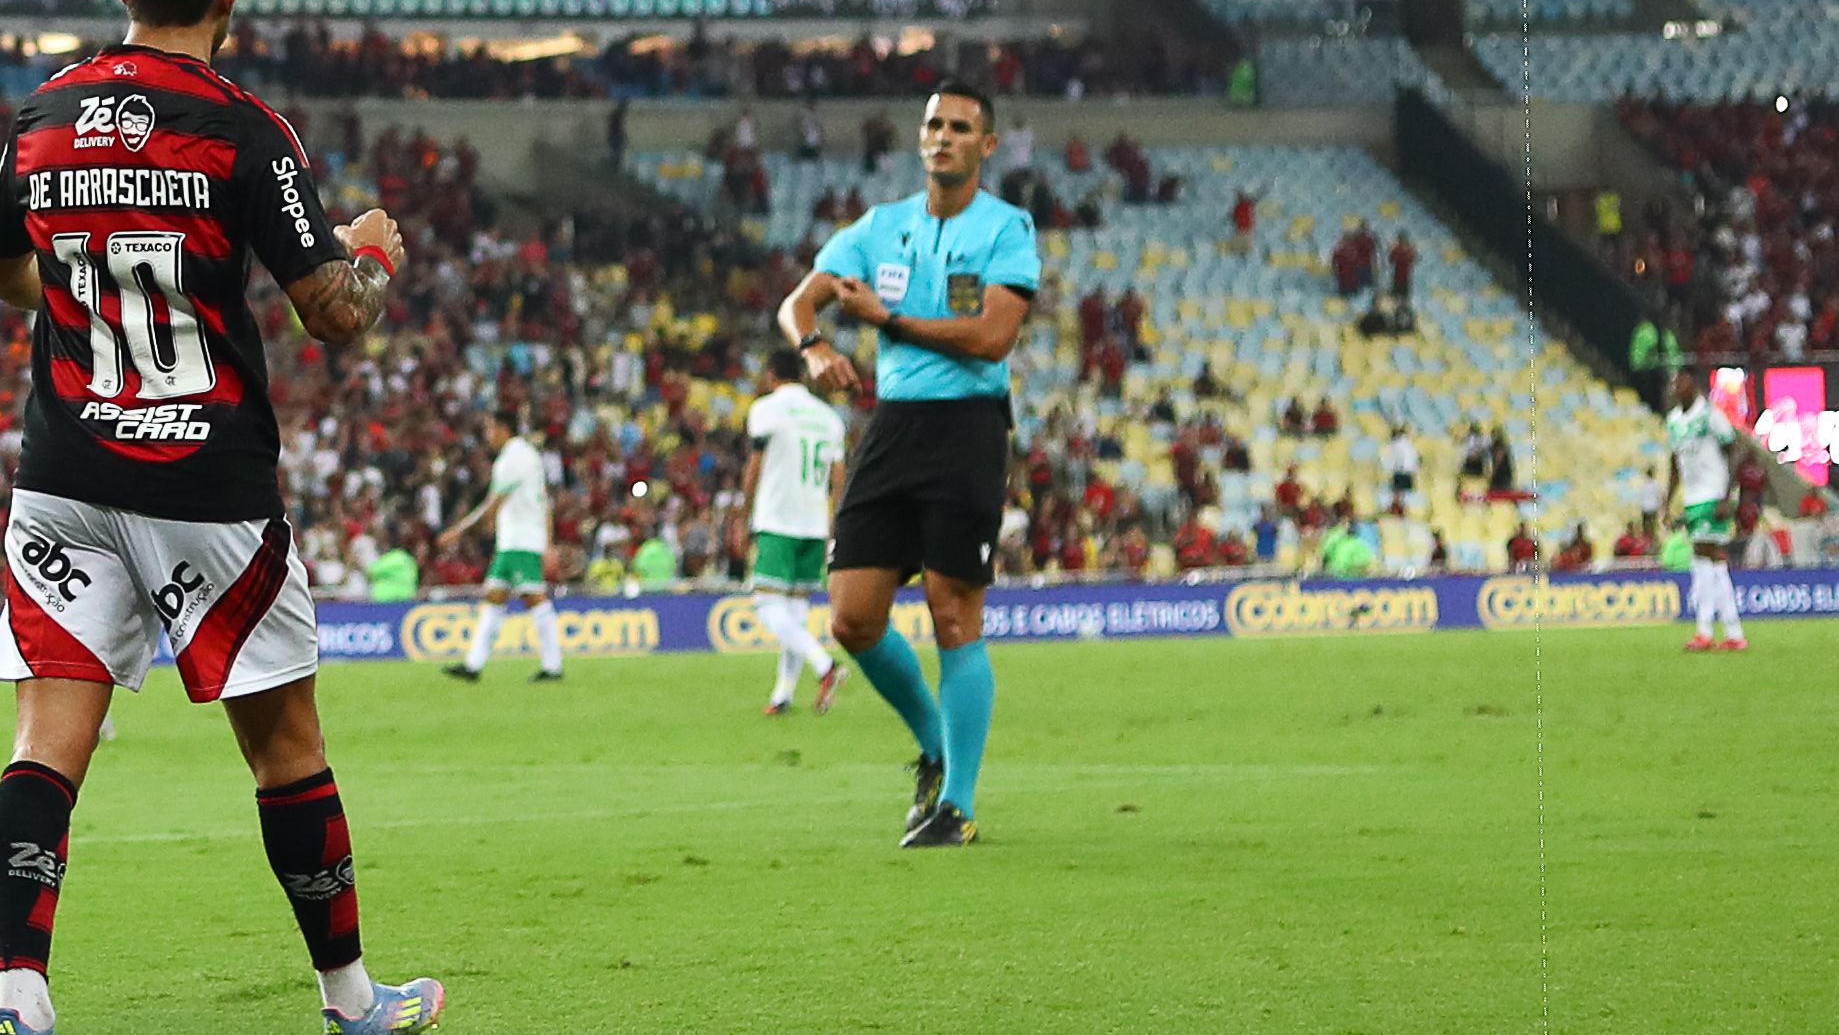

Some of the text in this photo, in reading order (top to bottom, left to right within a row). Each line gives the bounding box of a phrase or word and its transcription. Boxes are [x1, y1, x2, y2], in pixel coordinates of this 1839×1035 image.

[75, 96, 116, 135] Zé
[73, 135, 116, 149] DELIVERY
[29, 168, 210, 210] DE ARRASCAETA
[272, 156, 315, 249] Shopee
[125, 242, 172, 253] TEXACO
[52, 231, 216, 400] 10
[80, 401, 202, 422] ASSIST
[114, 420, 210, 441] CARD
[800, 436, 830, 487] 16
[21, 535, 92, 603] abc
[8, 842, 56, 878] Zé
[8, 869, 56, 887] DELIVERY
